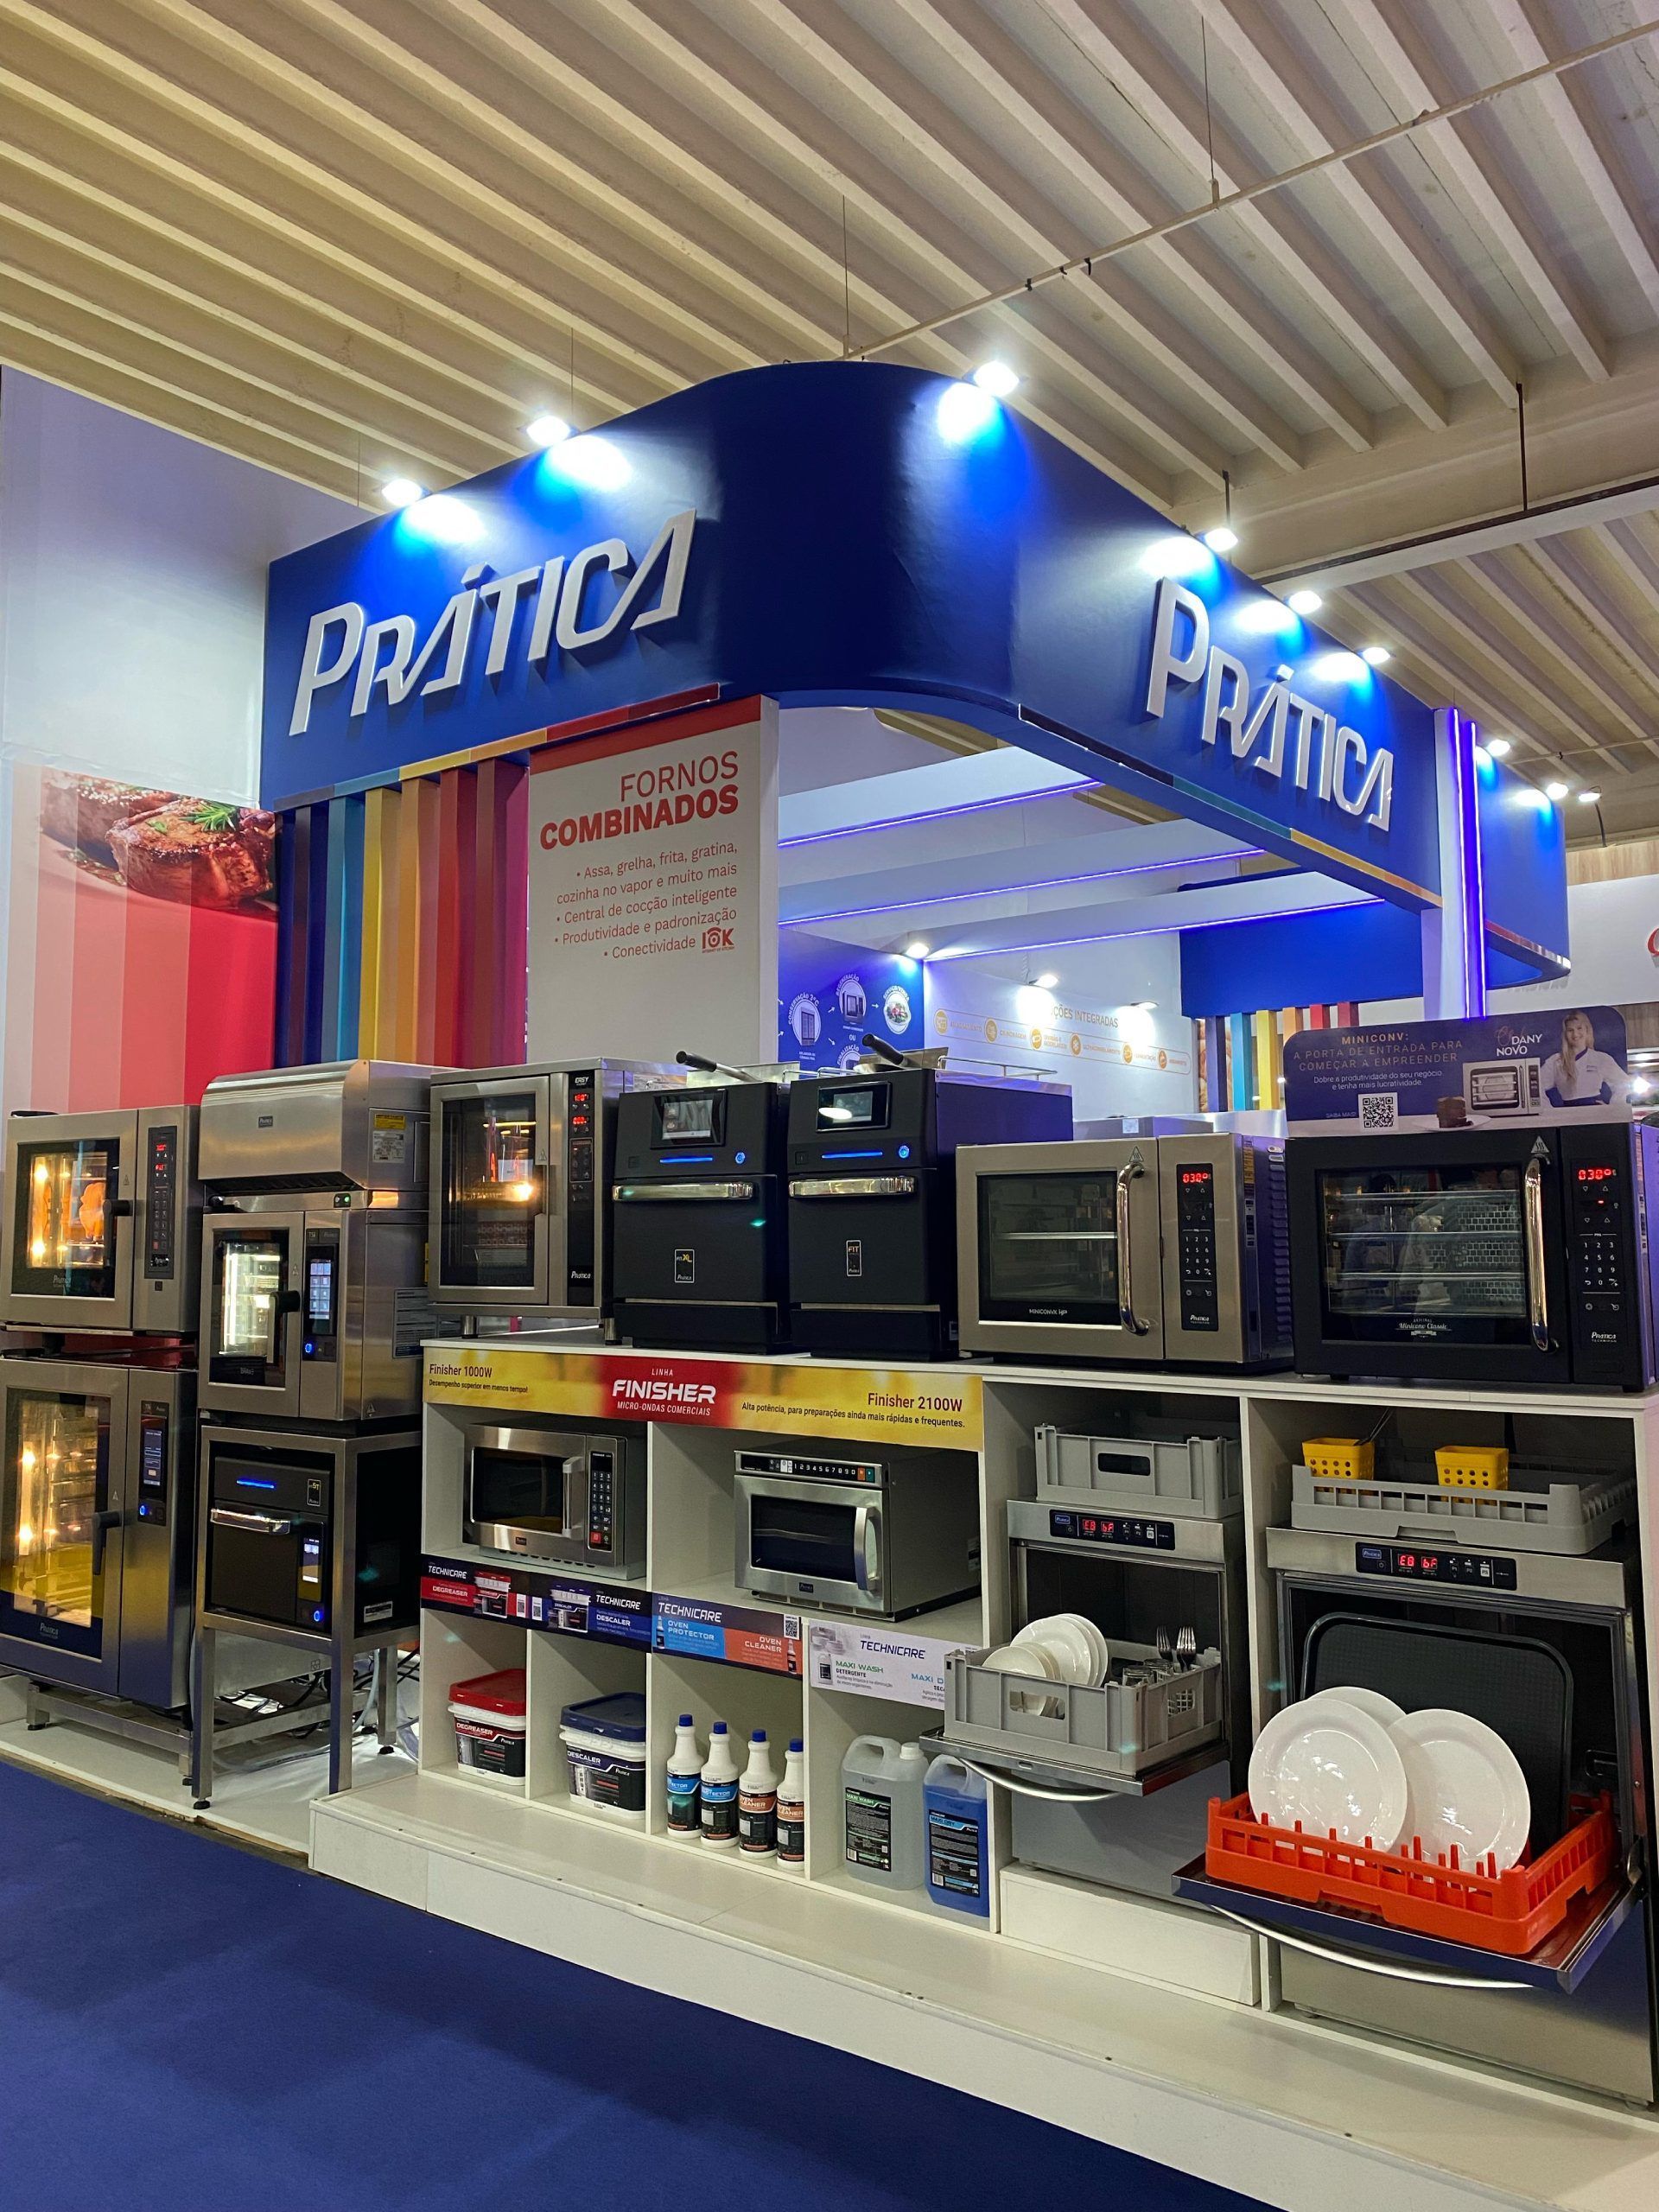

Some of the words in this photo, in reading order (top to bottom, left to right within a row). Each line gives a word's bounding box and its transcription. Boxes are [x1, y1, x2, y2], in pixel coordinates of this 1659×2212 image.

[620, 751, 738, 802] FORNOS
[540, 785, 738, 850] COMBINADOS
[584, 866, 613, 879] Assa,
[617, 857, 655, 876] grelha,
[659, 851, 687, 864] frita,
[691, 842, 737, 862] gratina,
[557, 887, 599, 904] cozinha
[603, 886, 616, 896] no
[620, 878, 652, 896] vapor
[657, 878, 663, 887] e
[668, 870, 702, 885] muito
[708, 863, 736, 879] mais
[564, 906, 605, 923] Central
[608, 903, 621, 917] de
[626, 896, 667, 913] cocção
[672, 886, 737, 907] inteligente
[563, 925, 639, 944] Produtividade
[644, 923, 650, 932] e
[655, 908, 737, 934] padronização
[613, 936, 696, 958] Conectividade
[788, 992, 809, 1025] CONSERVAÇÃO
[1075, 1010, 1118, 1028] INTEGRADAS
[1341, 1033, 1408, 1045] MINICONV:
[1512, 1034, 1541, 1045] DANY
[1306, 1049, 1344, 1058] PORTA
[1349, 1046, 1364, 1056] DE
[1370, 1044, 1426, 1055] ENTRADA
[1432, 1040, 1462, 1050] PARA
[1497, 1043, 1528, 1056] NOVO
[1299, 1059, 1357, 1071] COMEÇAR
[1375, 1053, 1458, 1066] EMPREENDER
[1341, 1073, 1387, 1083] produtividade
[429, 1363, 461, 1376] Finisher
[464, 1366, 493, 1378] 1000W
[652, 1368, 673, 1376] LINHA
[429, 1379, 460, 1389] Desempenho
[461, 1382, 482, 1390] superior
[612, 1379, 715, 1404] FINISHER
[618, 1402, 665, 1412] MICRO-ONDAS
[667, 1404, 710, 1416] COMERCIAIS
[868, 1392, 914, 1409] Finisher
[918, 1396, 963, 1412] 2100W
[742, 1402, 754, 1411] Alta
[756, 1403, 786, 1414] potência,
[788, 1407, 803, 1415] para
[804, 1408, 845, 1419] preparações
[848, 1411, 866, 1420] ainda
[868, 1413, 885, 1421] mais
[887, 1414, 912, 1426] rápidas
[921, 1416, 965, 1428] frequentes.
[429, 1566, 467, 1579] TECHNICARE
[433, 1586, 467, 1597] DEGREASER
[596, 1594, 641, 1610] TECHNICARE
[658, 1602, 722, 1623] TECHNICARE
[596, 1614, 631, 1626] DESCALER
[668, 1620, 688, 1630] OVEN
[668, 1628, 715, 1641] PROTECTOR
[760, 1636, 782, 1645] OVEN
[744, 1641, 782, 1653] CLEANER
[861, 1640, 925, 1659] TECHNICARE
[836, 1661, 855, 1669] MAXI
[858, 1664, 883, 1673] WASH
[836, 1668, 866, 1678] DETERGENTE
[911, 1674, 933, 1682] MAXI
[567, 1751, 601, 1764] DESCALER
